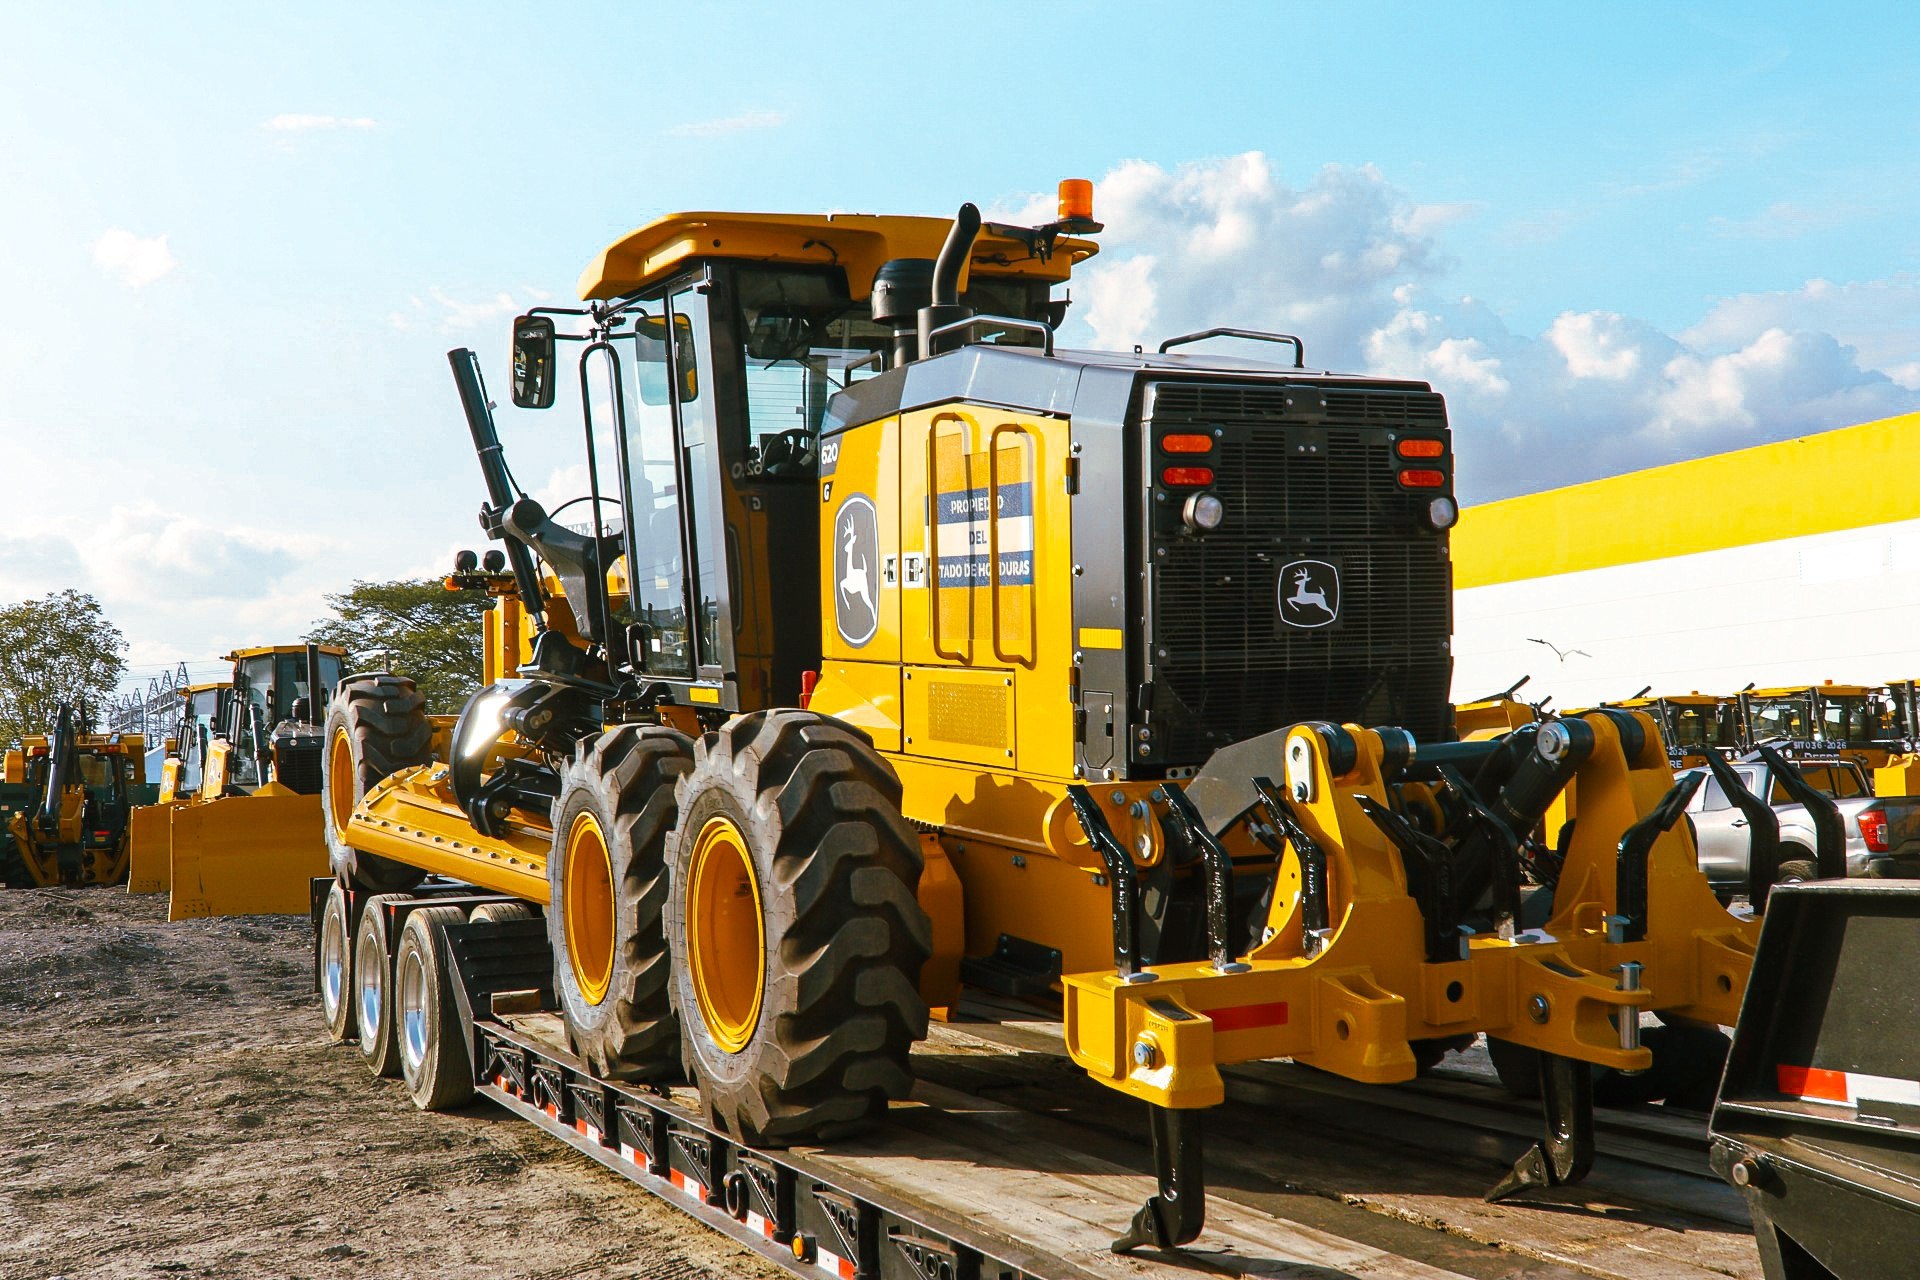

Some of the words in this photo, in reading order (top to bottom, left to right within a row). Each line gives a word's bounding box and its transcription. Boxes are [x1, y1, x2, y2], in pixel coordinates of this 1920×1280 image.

[821, 442, 838, 465] 620
[823, 483, 830, 501] G
[950, 495, 1004, 514] PROPIEDD
[969, 530, 987, 545] DEL
[938, 563, 962, 578] TADO
[964, 563, 977, 578] DE
[978, 560, 1030, 577] HODURAS
